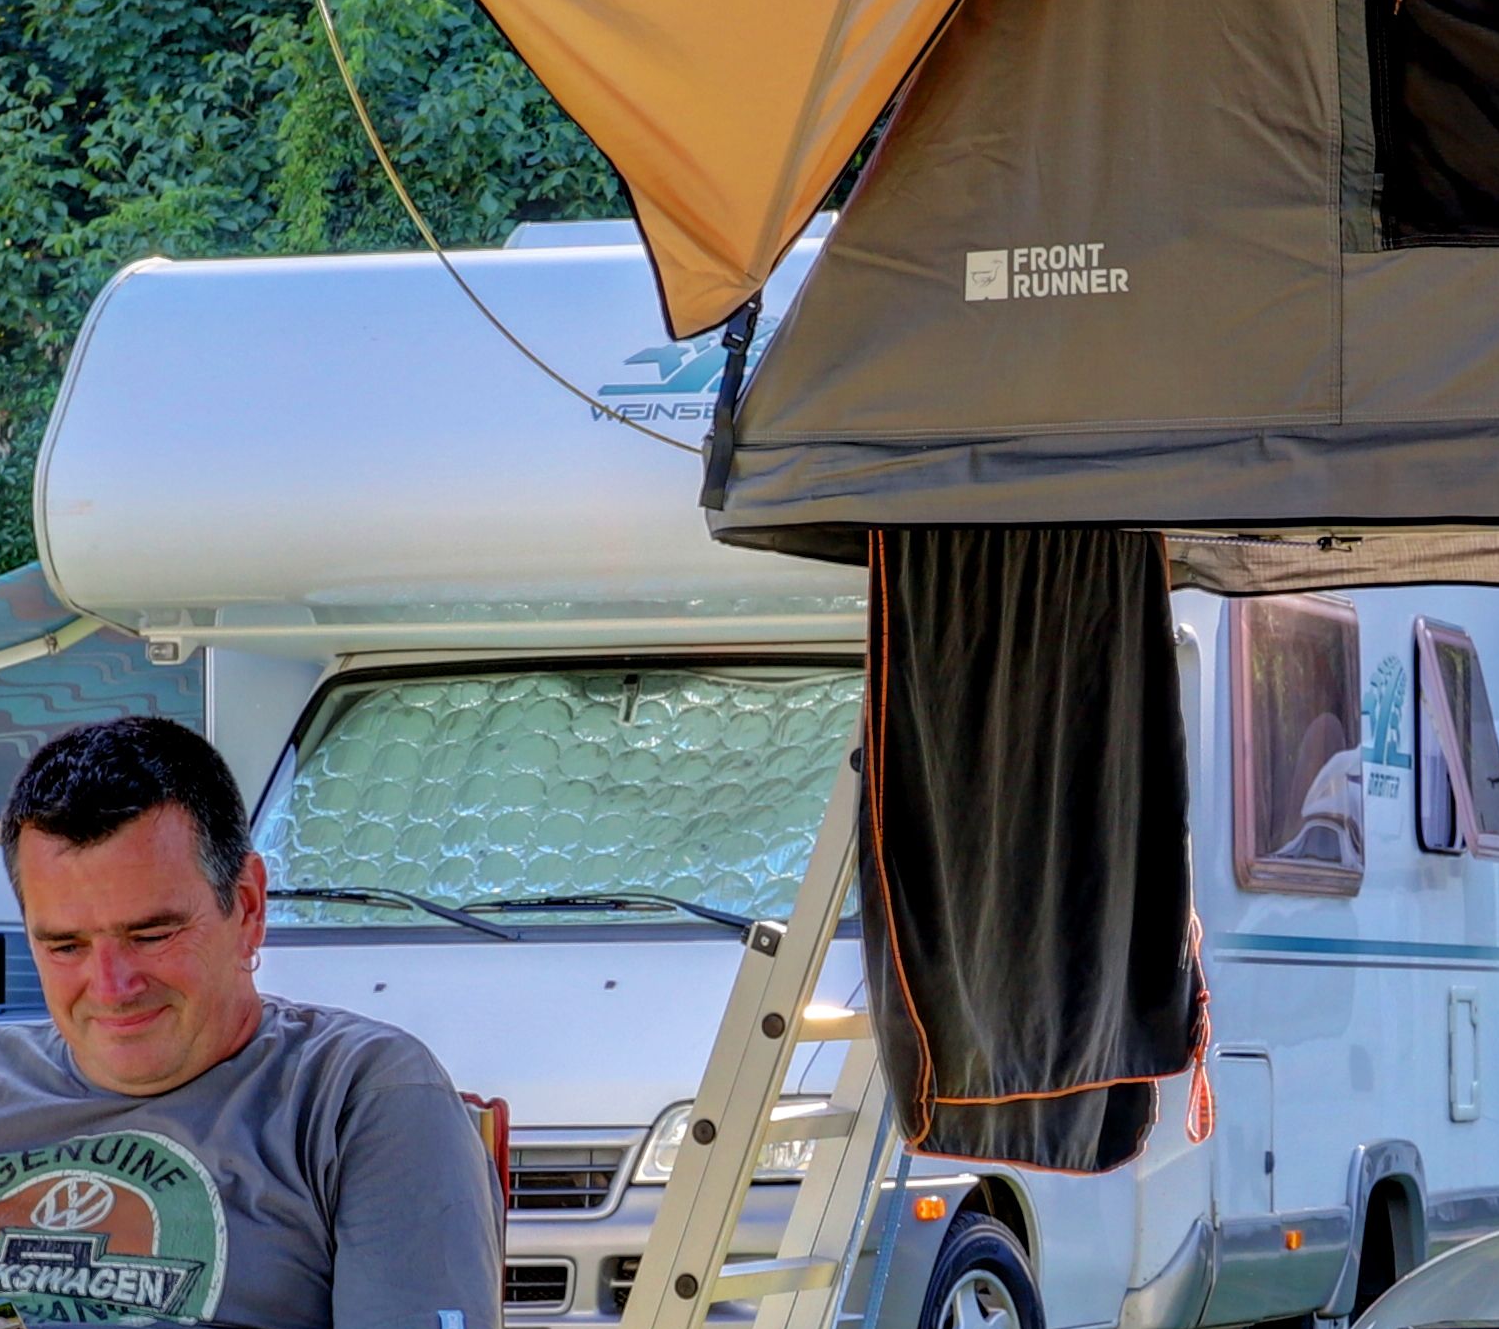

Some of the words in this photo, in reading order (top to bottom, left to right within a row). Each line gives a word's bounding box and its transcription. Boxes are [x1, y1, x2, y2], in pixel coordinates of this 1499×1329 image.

[1013, 243, 1104, 272] FRONT
[1013, 268, 1129, 298] RUNNER
[590, 401, 715, 423] WEINS
